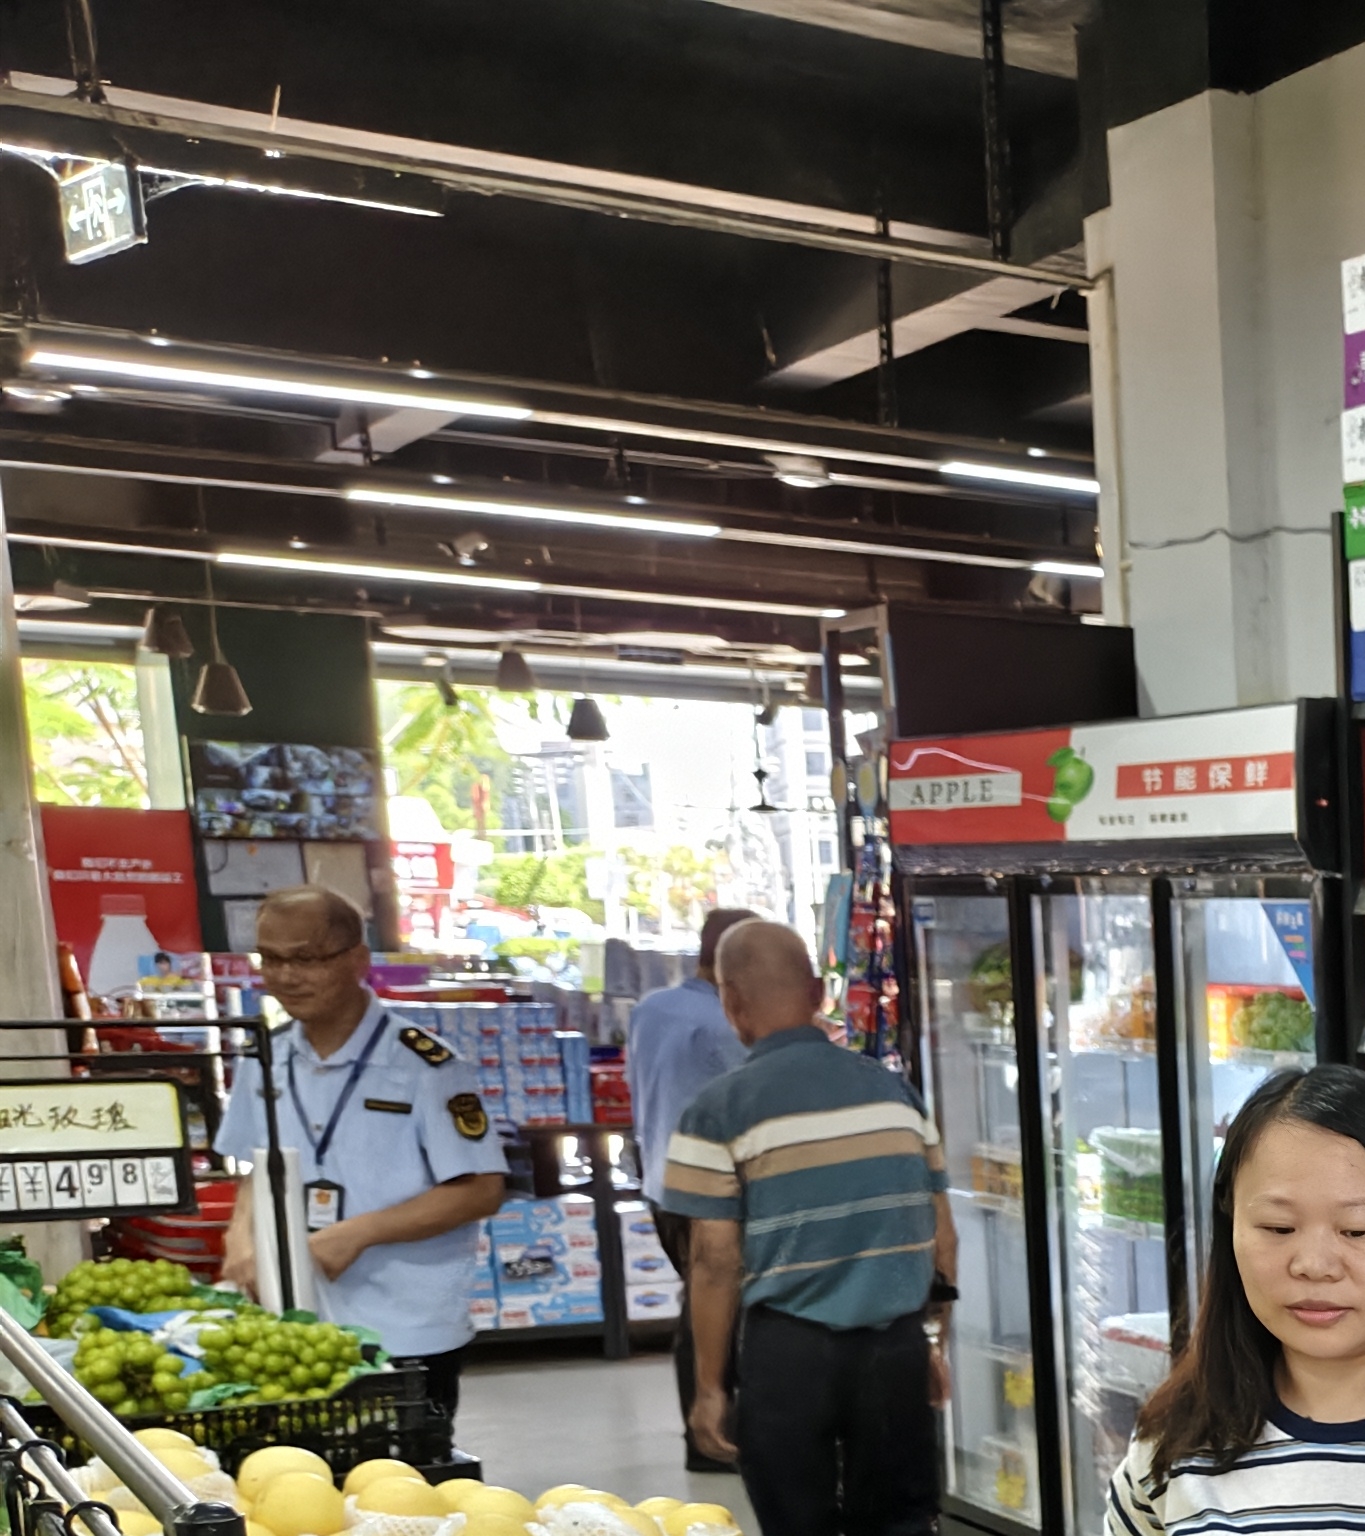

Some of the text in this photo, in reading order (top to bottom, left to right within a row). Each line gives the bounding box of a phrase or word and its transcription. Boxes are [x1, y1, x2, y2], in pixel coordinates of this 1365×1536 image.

[910, 778, 994, 806] APPLE
[1140, 759, 1269, 794] 节能保鲜
